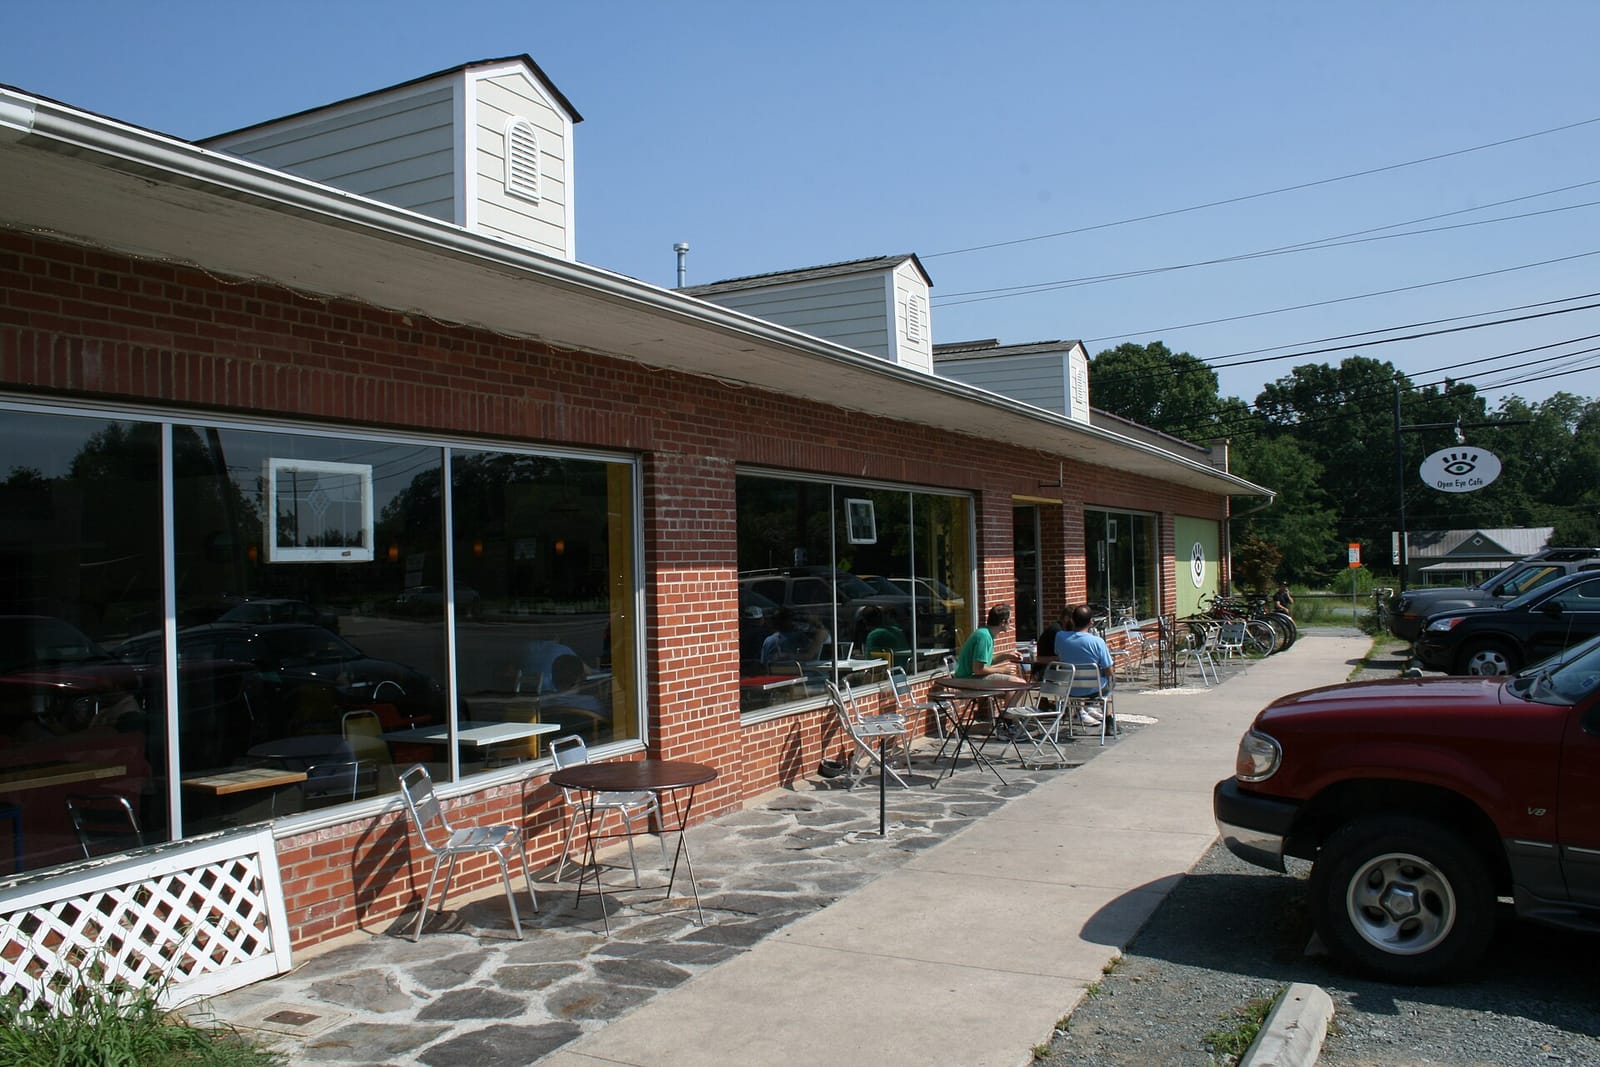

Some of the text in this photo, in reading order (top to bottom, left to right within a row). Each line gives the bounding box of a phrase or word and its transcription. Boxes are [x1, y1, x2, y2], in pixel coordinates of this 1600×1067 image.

[1437, 480, 1453, 489] Open
[1455, 479, 1466, 488] Eye
[1527, 807, 1547, 816] V8
